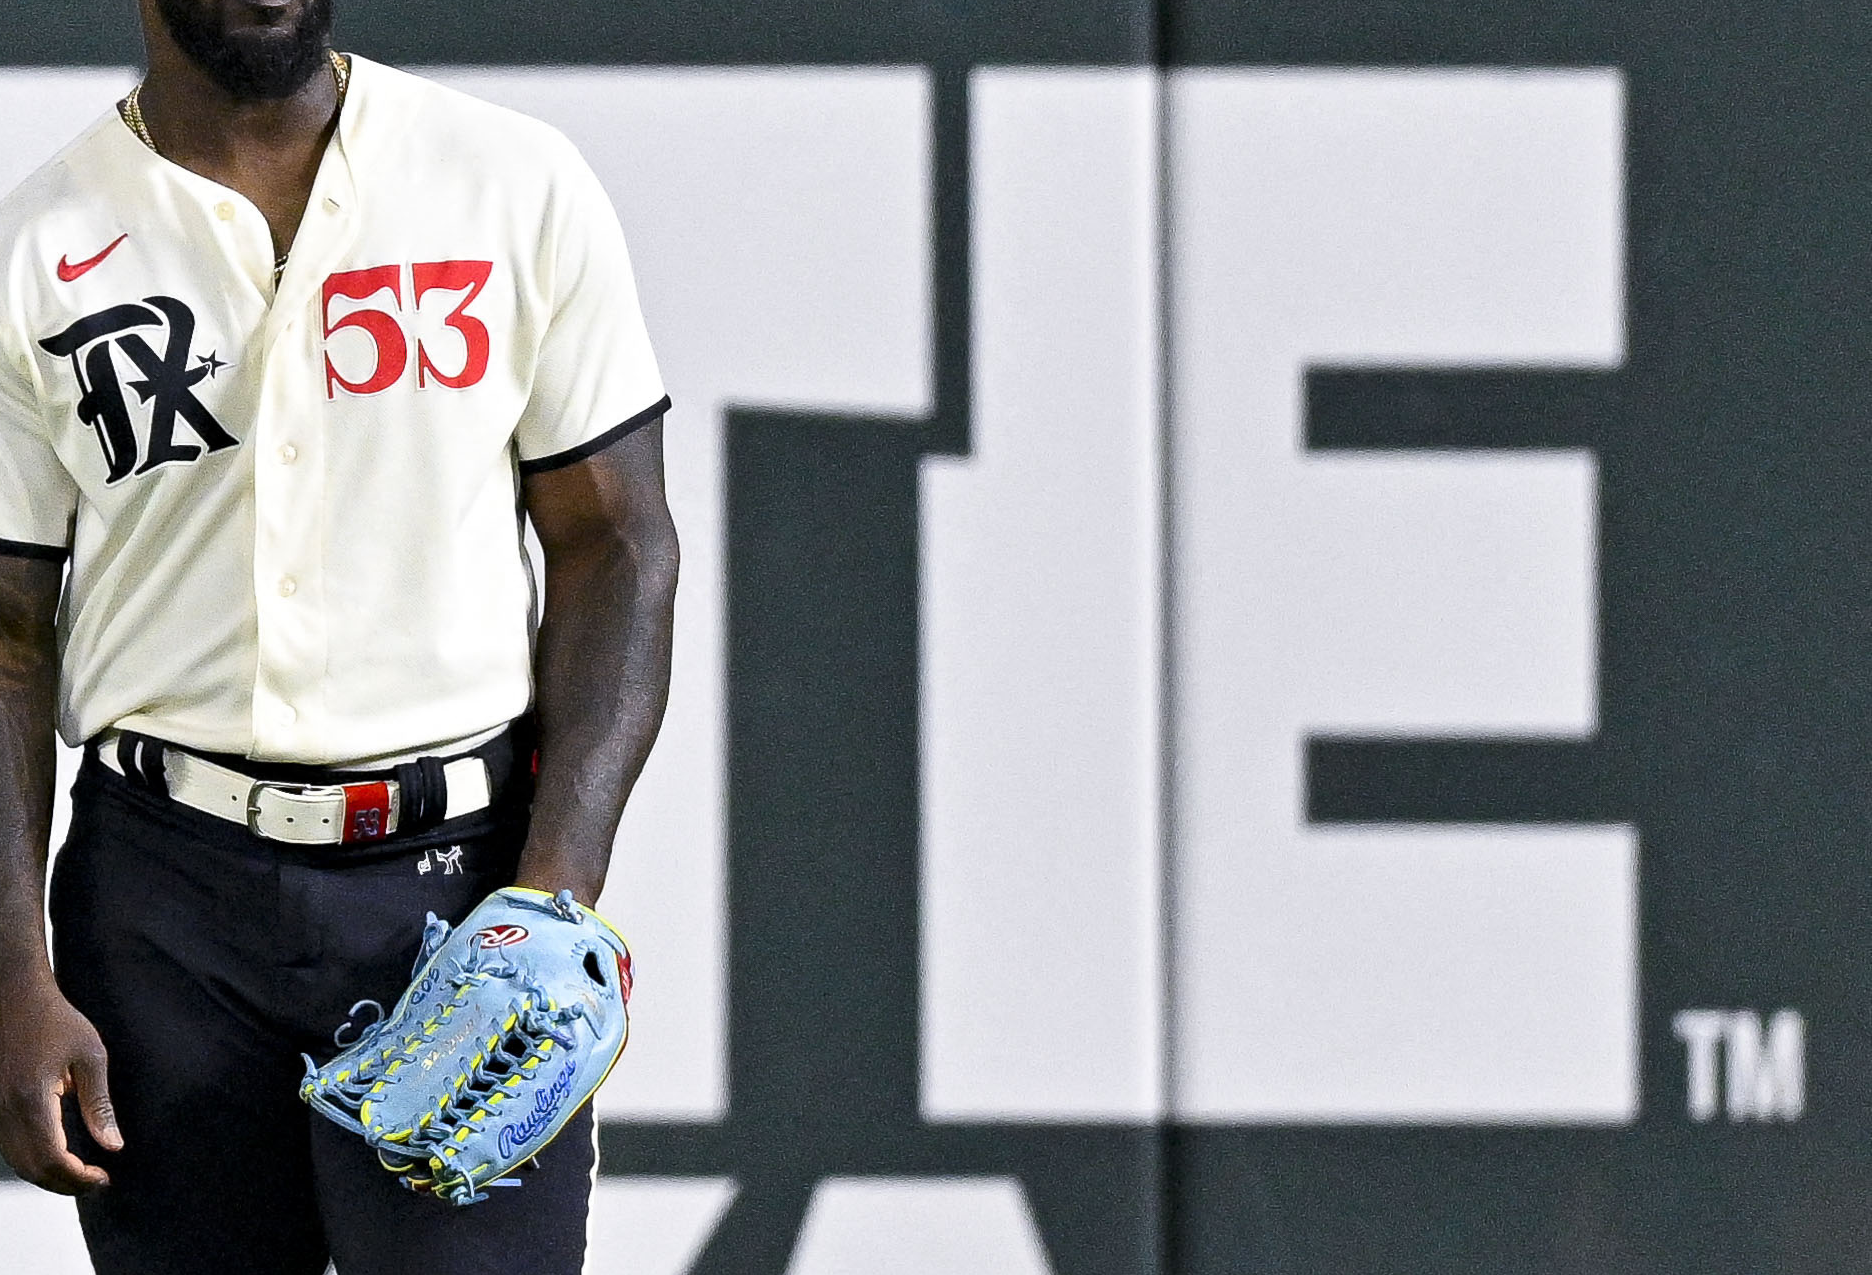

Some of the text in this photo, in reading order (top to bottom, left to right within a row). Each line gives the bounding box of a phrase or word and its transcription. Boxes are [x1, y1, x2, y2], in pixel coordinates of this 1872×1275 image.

[322, 260, 492, 399] 53
[352, 807, 381, 839] 53
[497, 1057, 578, 1160] Rawlings
